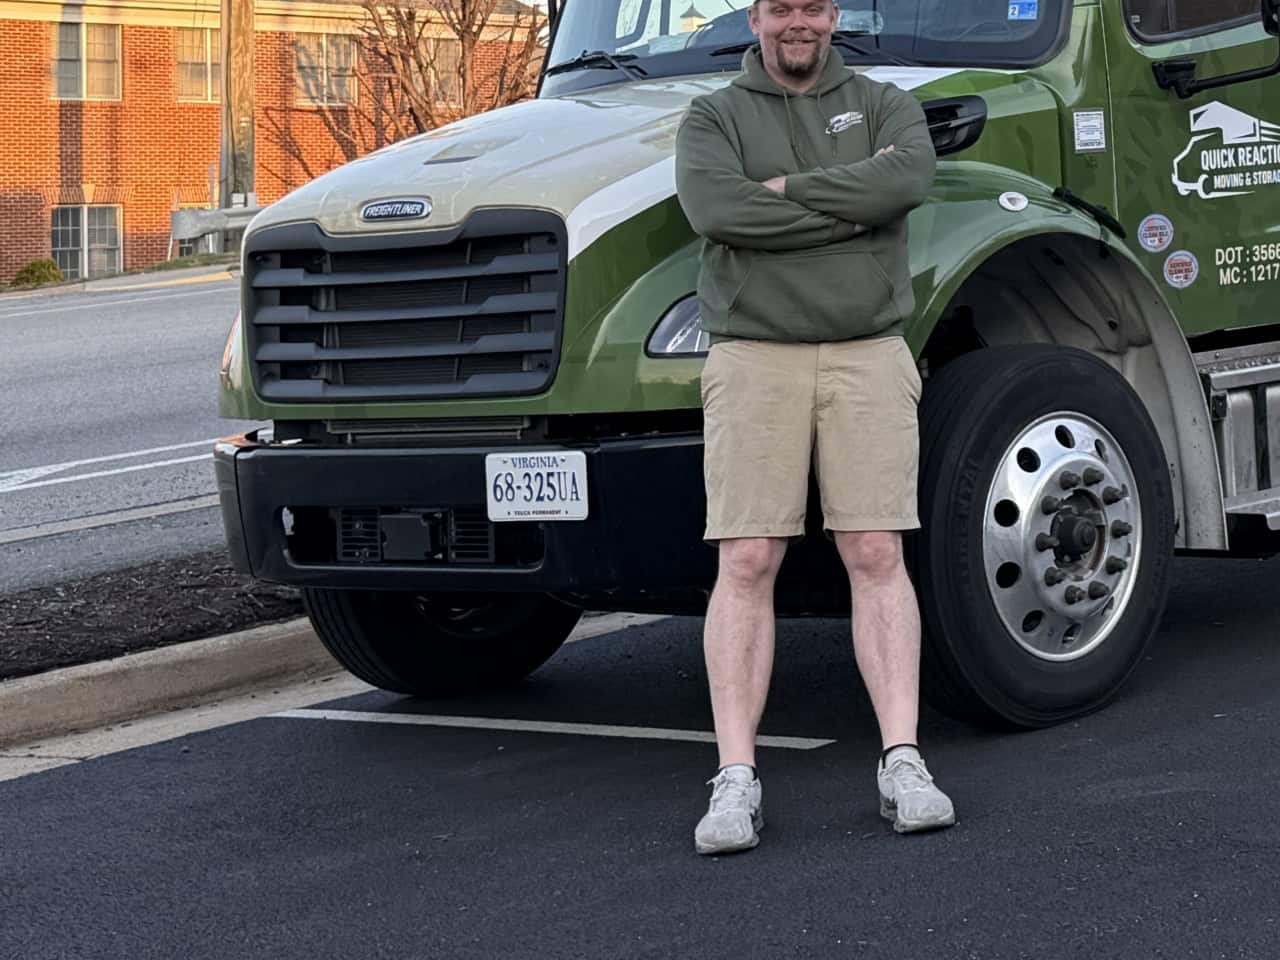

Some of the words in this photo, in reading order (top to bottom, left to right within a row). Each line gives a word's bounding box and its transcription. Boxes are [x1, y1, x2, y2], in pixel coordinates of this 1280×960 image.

[1200, 147, 1237, 171] QUICK
[1213, 172, 1244, 189] MOVING
[1245, 172, 1252, 186] &
[364, 203, 422, 217] FREIGHTLINER
[511, 456, 559, 469] VIRGINIA
[493, 471, 581, 502] 68-325UA
